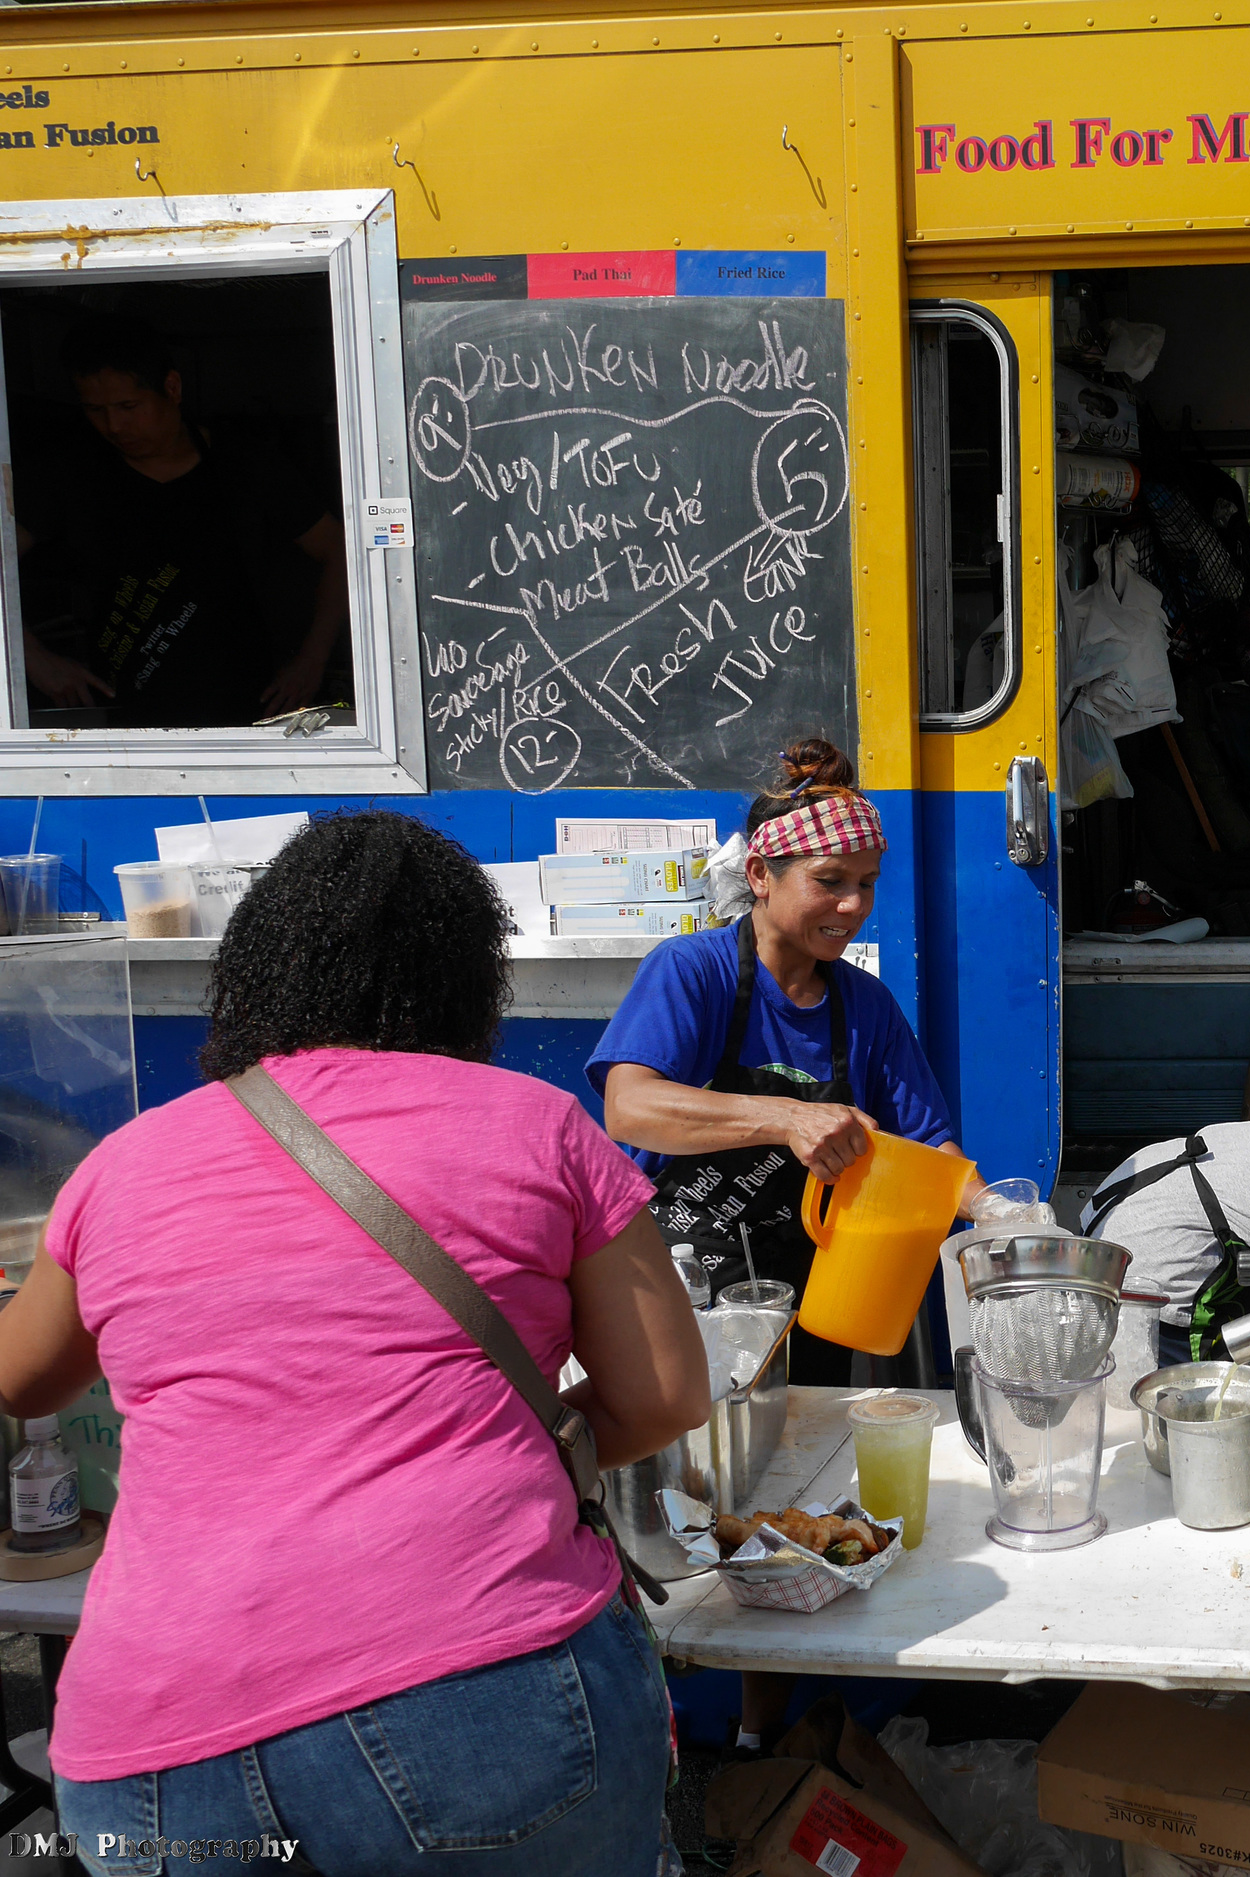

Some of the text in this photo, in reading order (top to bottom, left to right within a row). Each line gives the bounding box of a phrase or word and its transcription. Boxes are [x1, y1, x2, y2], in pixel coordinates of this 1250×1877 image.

[43, 121, 160, 148] Fusion
[916, 120, 1055, 174] Food
[1070, 117, 1173, 169] For
[412, 272, 497, 285] Drunken Noodle
[572, 267, 632, 281] Pad Thai
[717, 266, 786, 279] Fried Rice
[380, 506, 408, 515] Square
[139, 624, 166, 656] Twitter
[156, 640, 171, 655] on
[164, 601, 198, 638] Wheels
[666, 862, 674, 891] GLOVES
[733, 1151, 786, 1198] Fusion
[1109, 1807, 1196, 1836] WIN SONE
